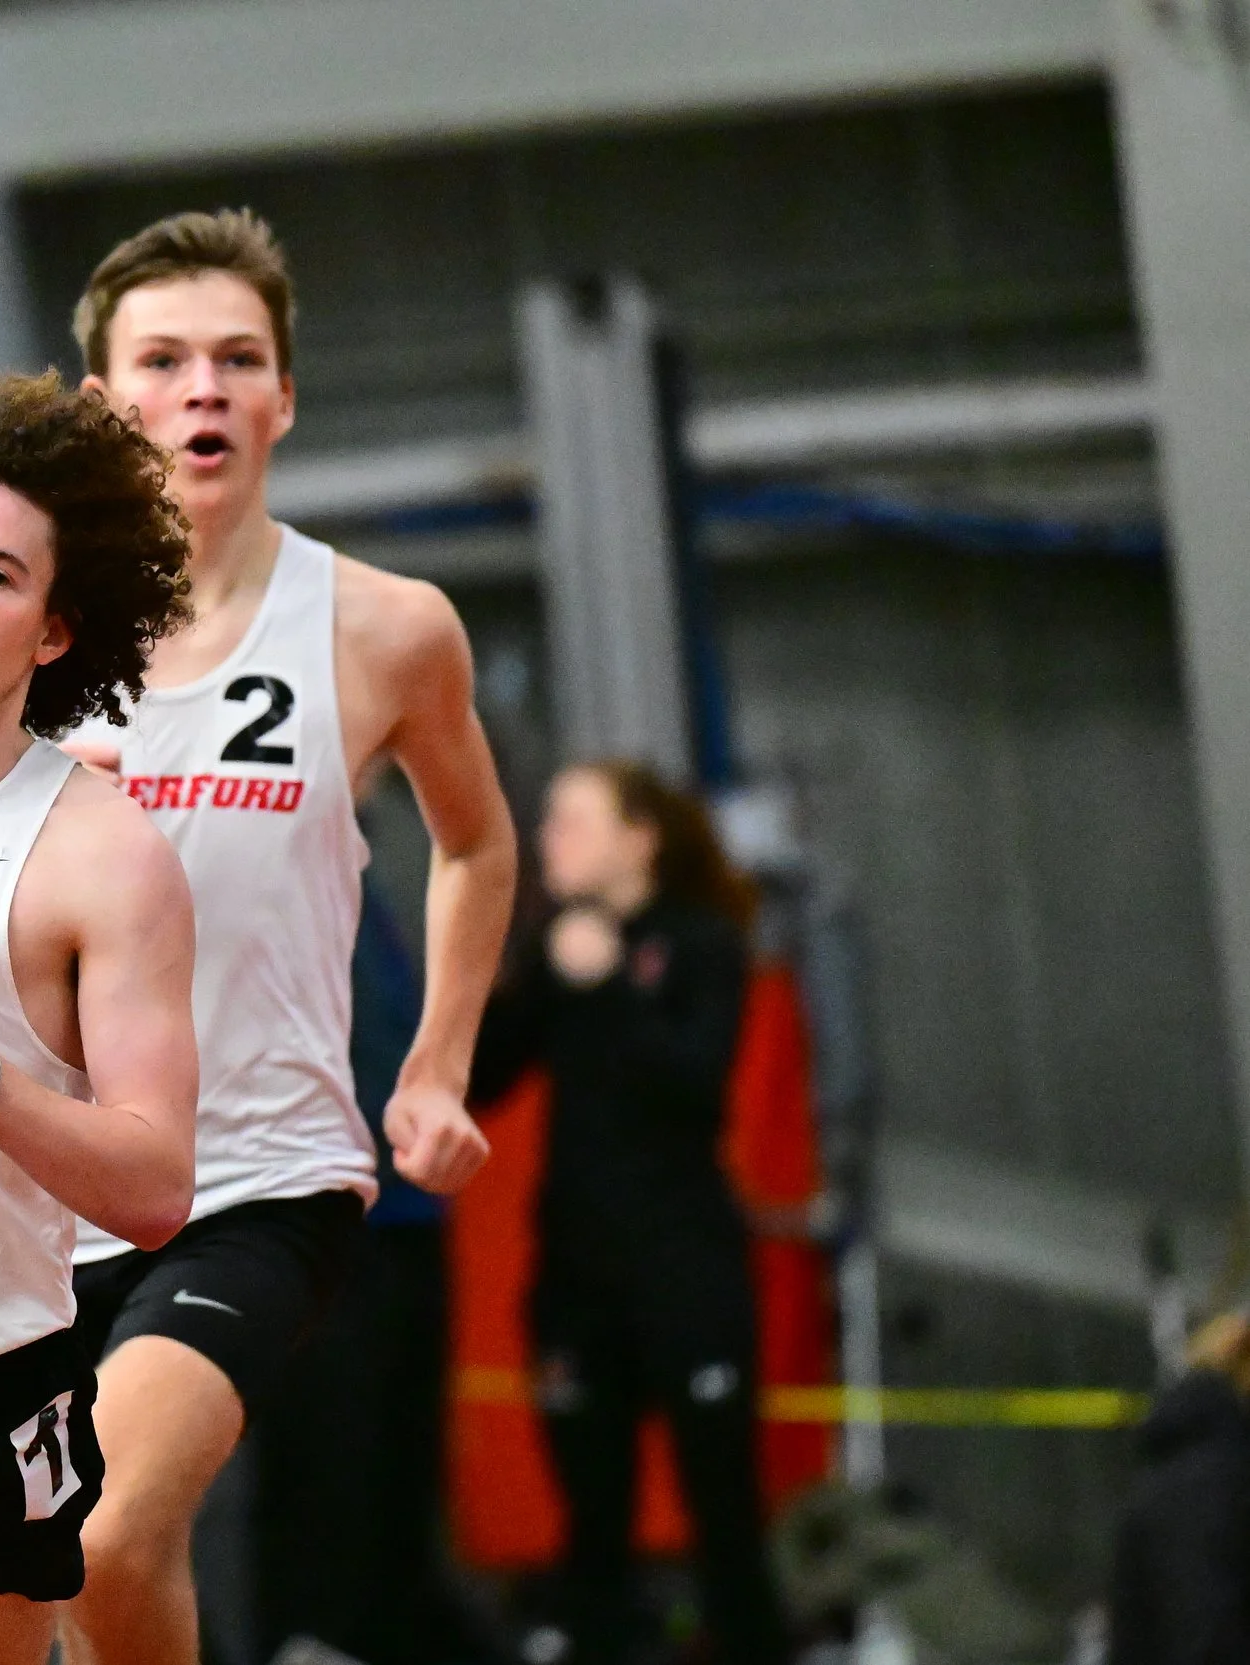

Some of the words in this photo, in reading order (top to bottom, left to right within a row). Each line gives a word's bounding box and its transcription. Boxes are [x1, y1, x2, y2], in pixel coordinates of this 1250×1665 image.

[220, 675, 294, 764] 2
[127, 774, 304, 813] ERFORD
[23, 1402, 63, 1498] 1
